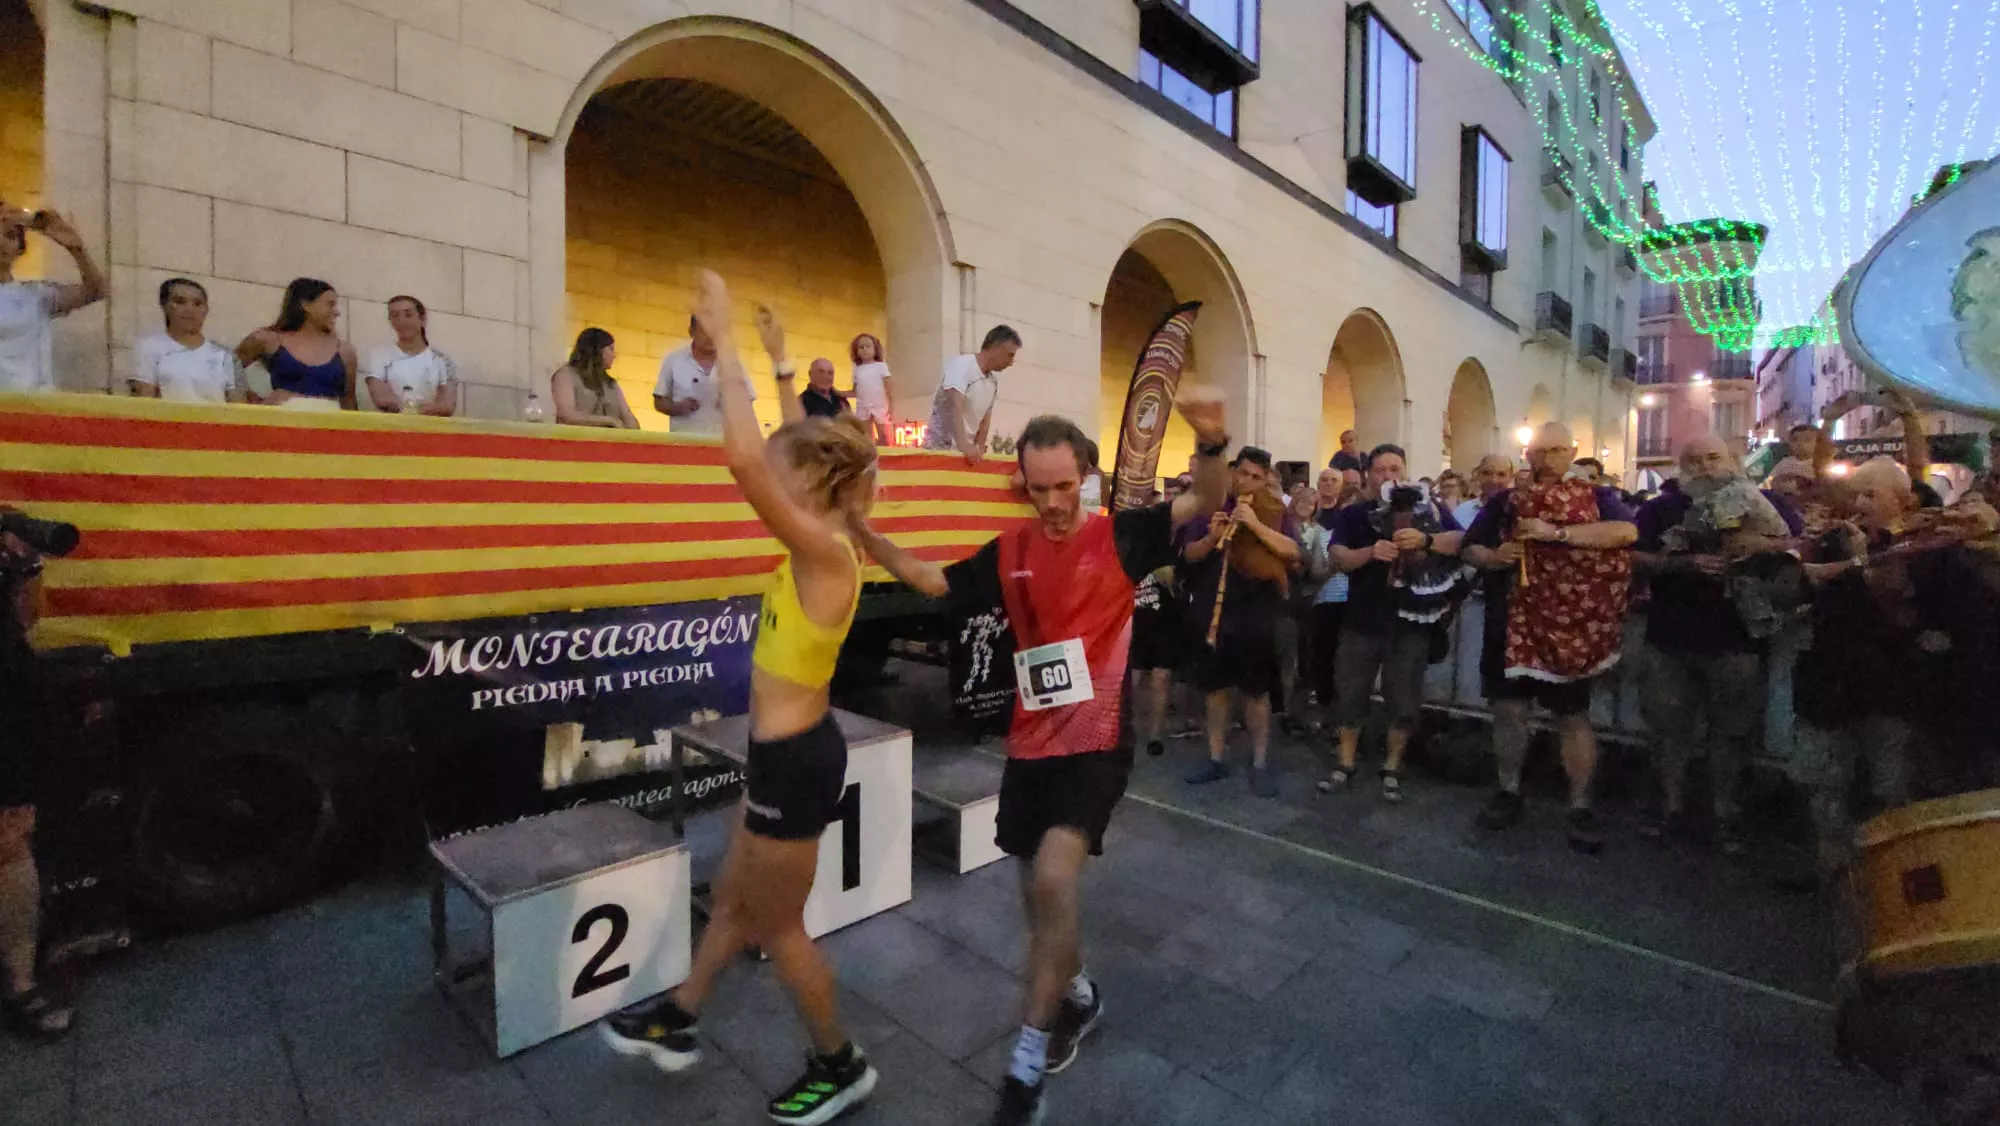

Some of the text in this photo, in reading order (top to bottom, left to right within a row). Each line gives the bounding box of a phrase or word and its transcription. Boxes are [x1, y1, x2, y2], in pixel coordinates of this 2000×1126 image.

[1845, 443, 1880, 454] CAJA
[411, 606, 759, 679] MONTEARAGÓN
[471, 661, 715, 711] PIEDRA A PIEDRA
[1041, 664, 1069, 689] 60
[830, 781, 861, 892] 1
[571, 902, 630, 999] 2
